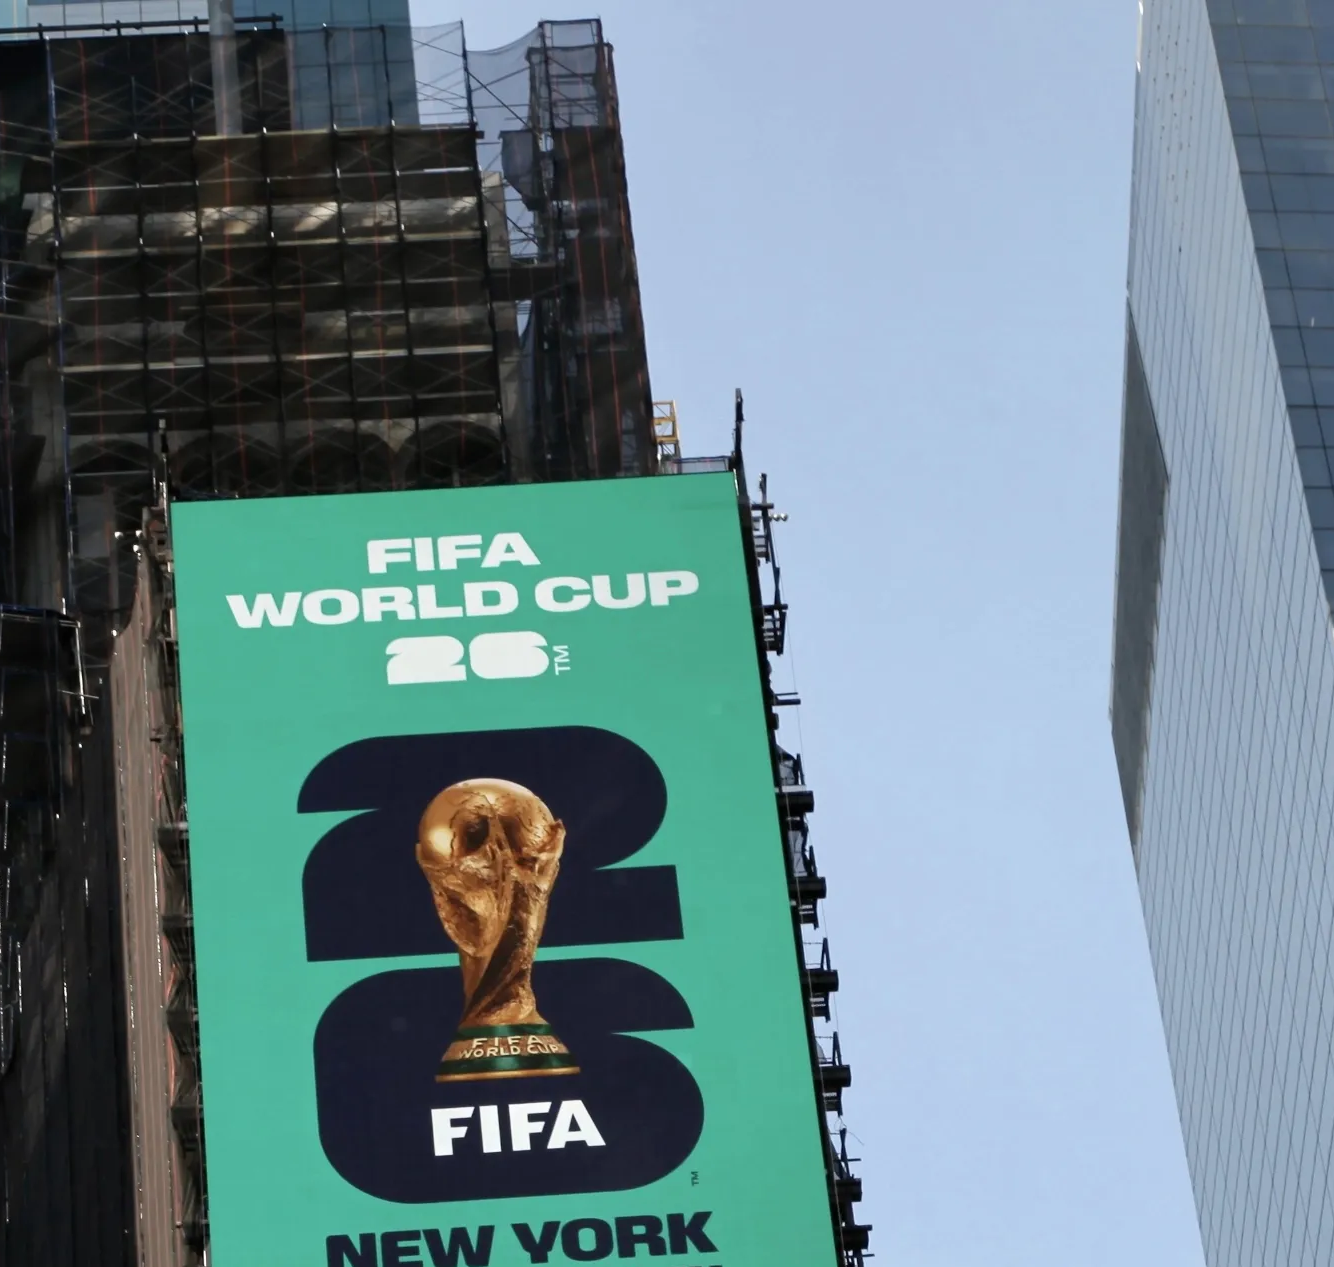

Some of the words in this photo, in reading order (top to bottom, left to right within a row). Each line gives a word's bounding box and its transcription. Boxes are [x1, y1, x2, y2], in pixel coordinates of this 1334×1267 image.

[366, 532, 541, 574] FIFA
[226, 580, 519, 629] WORLD
[534, 570, 699, 613] CUP
[385, 631, 549, 685] 26
[459, 1047, 521, 1059] WORLD
[526, 1044, 560, 1055] CUP
[472, 1035, 543, 1049] FIFA
[430, 1099, 606, 1157] FIFA
[510, 1210, 720, 1265] YORK
